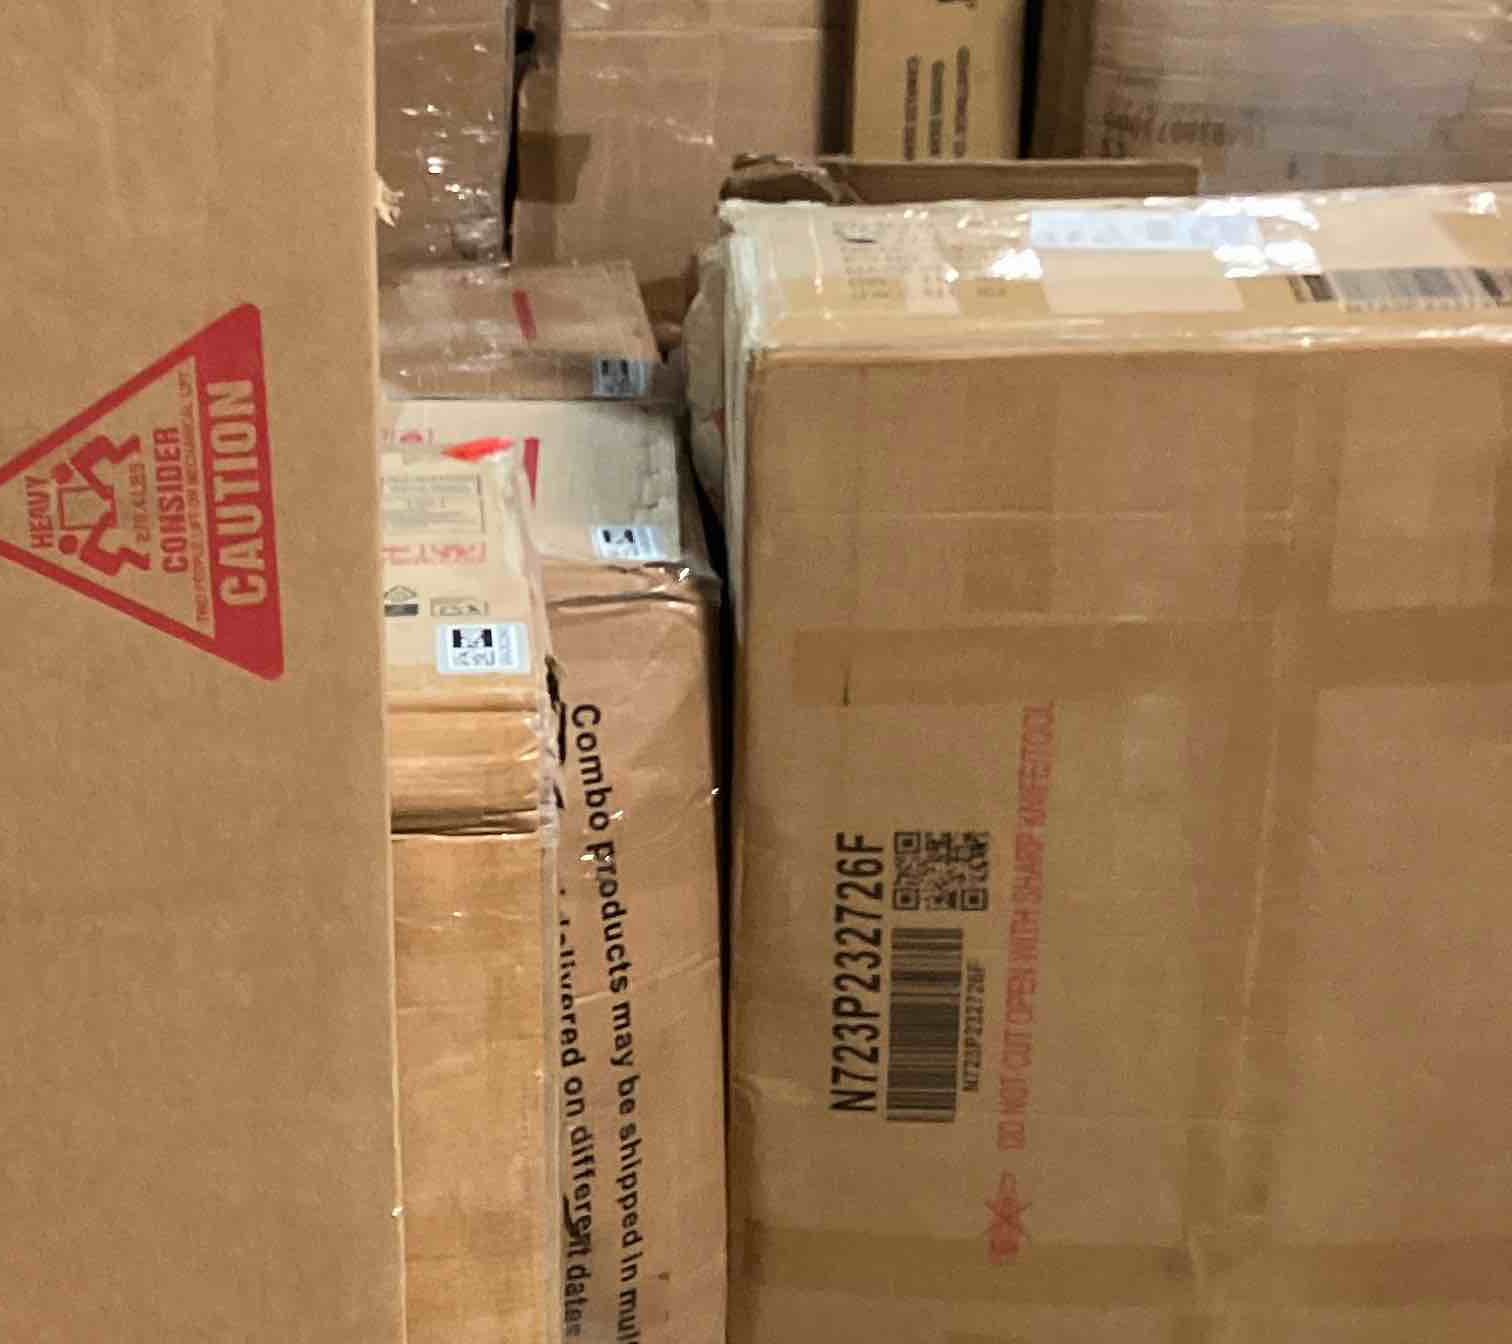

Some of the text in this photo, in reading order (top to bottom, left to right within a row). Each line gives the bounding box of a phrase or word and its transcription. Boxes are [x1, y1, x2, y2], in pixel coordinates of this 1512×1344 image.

[23, 474, 54, 549] HEAVY
[152, 426, 189, 575] CONSIDER
[206, 379, 268, 606] CAUTION
[571, 703, 616, 832] Combo
[1011, 831, 1046, 904] SHARP
[583, 842, 636, 993] products
[1006, 910, 1040, 963] WITH
[828, 831, 885, 1113] N723P232726F
[1003, 967, 1035, 1025] OPEN
[610, 1002, 636, 1067] may
[1001, 1029, 1032, 1071] CUT
[564, 1075, 590, 1118] on
[618, 1074, 641, 1114] be
[999, 1076, 1029, 1116] NOT
[997, 1120, 1025, 1152] DO
[566, 1125, 597, 1257] different
[616, 1121, 644, 1248] shipped
[563, 1262, 591, 1337] dates
[621, 1251, 644, 1283] in
